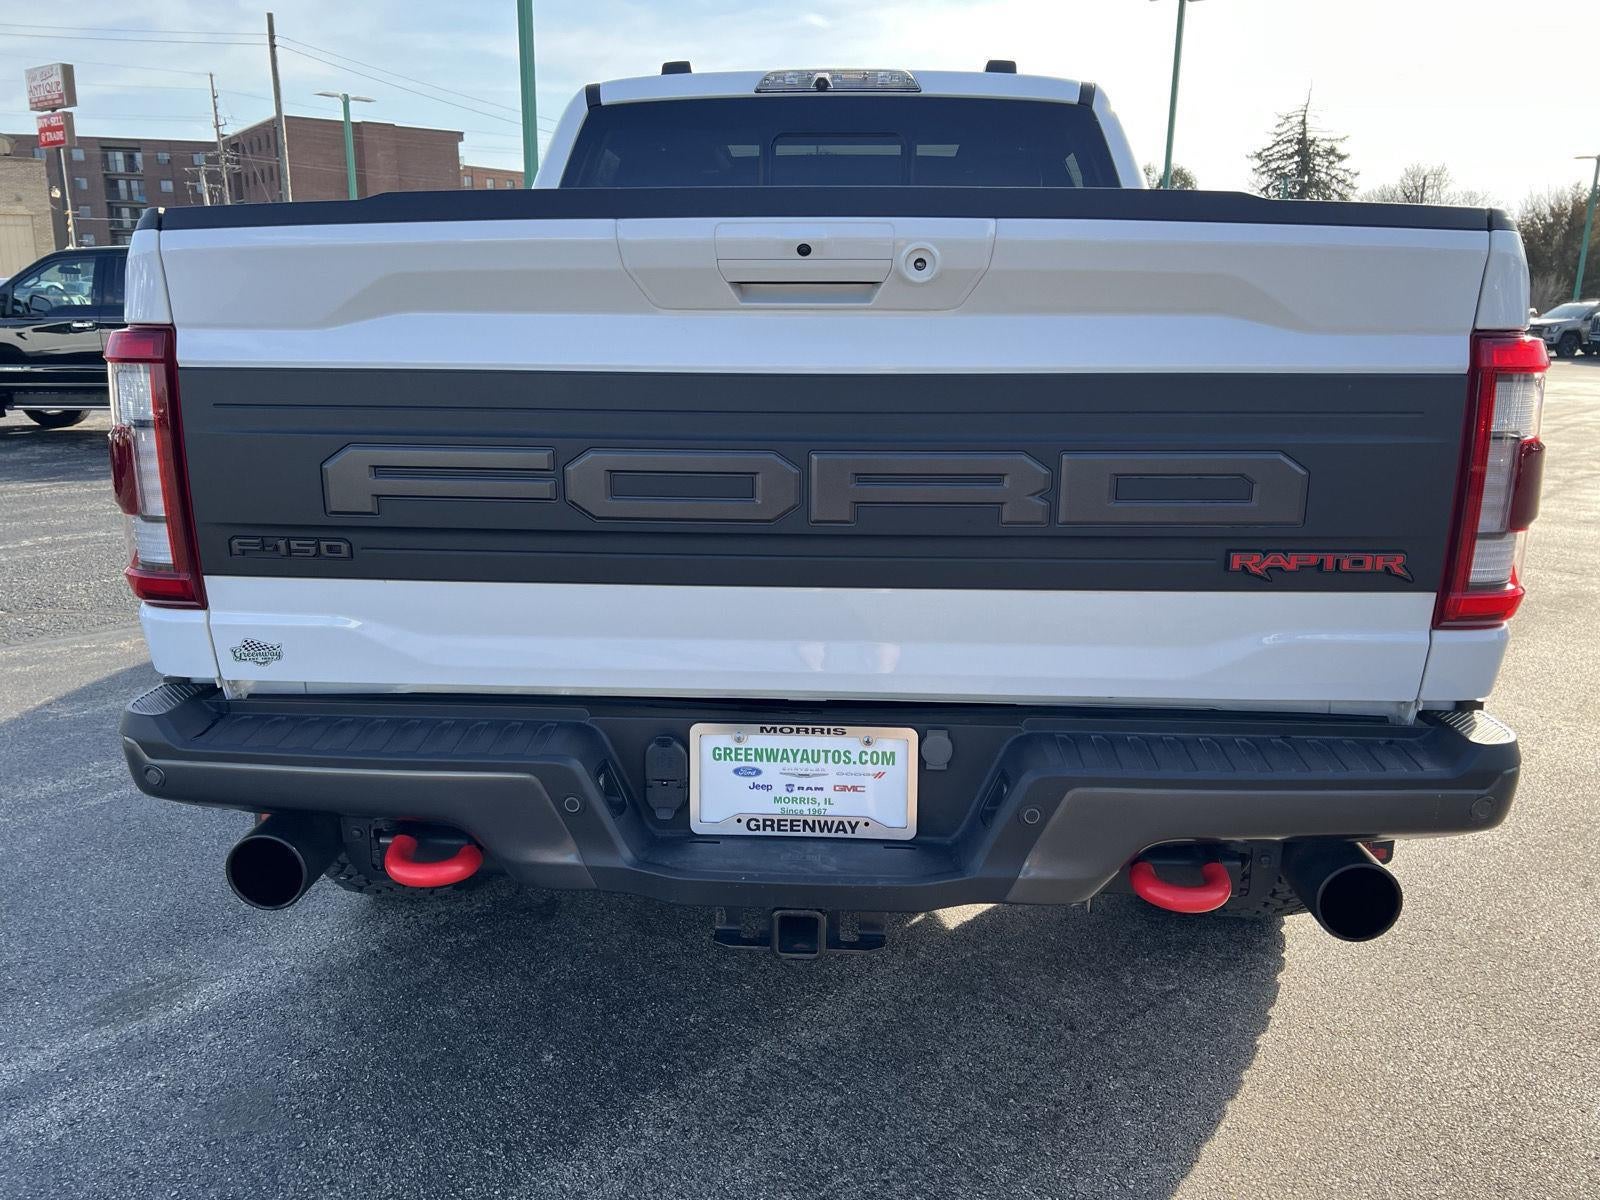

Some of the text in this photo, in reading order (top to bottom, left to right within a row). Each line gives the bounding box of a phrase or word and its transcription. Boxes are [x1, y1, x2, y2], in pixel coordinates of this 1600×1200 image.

[322, 445, 1308, 526] FORD
[229, 535, 352, 560] F-150
[1227, 551, 1413, 582] RAPTOR
[231, 647, 281, 661] Greenway
[759, 726, 847, 736] MORRIS
[711, 746, 896, 766] GREENWAYAUTOS.COM
[748, 782, 773, 792] Jeep
[833, 784, 866, 792] GMC
[773, 796, 834, 806] MORRIS, IL
[780, 807, 805, 815] Since
[746, 818, 860, 834] GREENWAY
